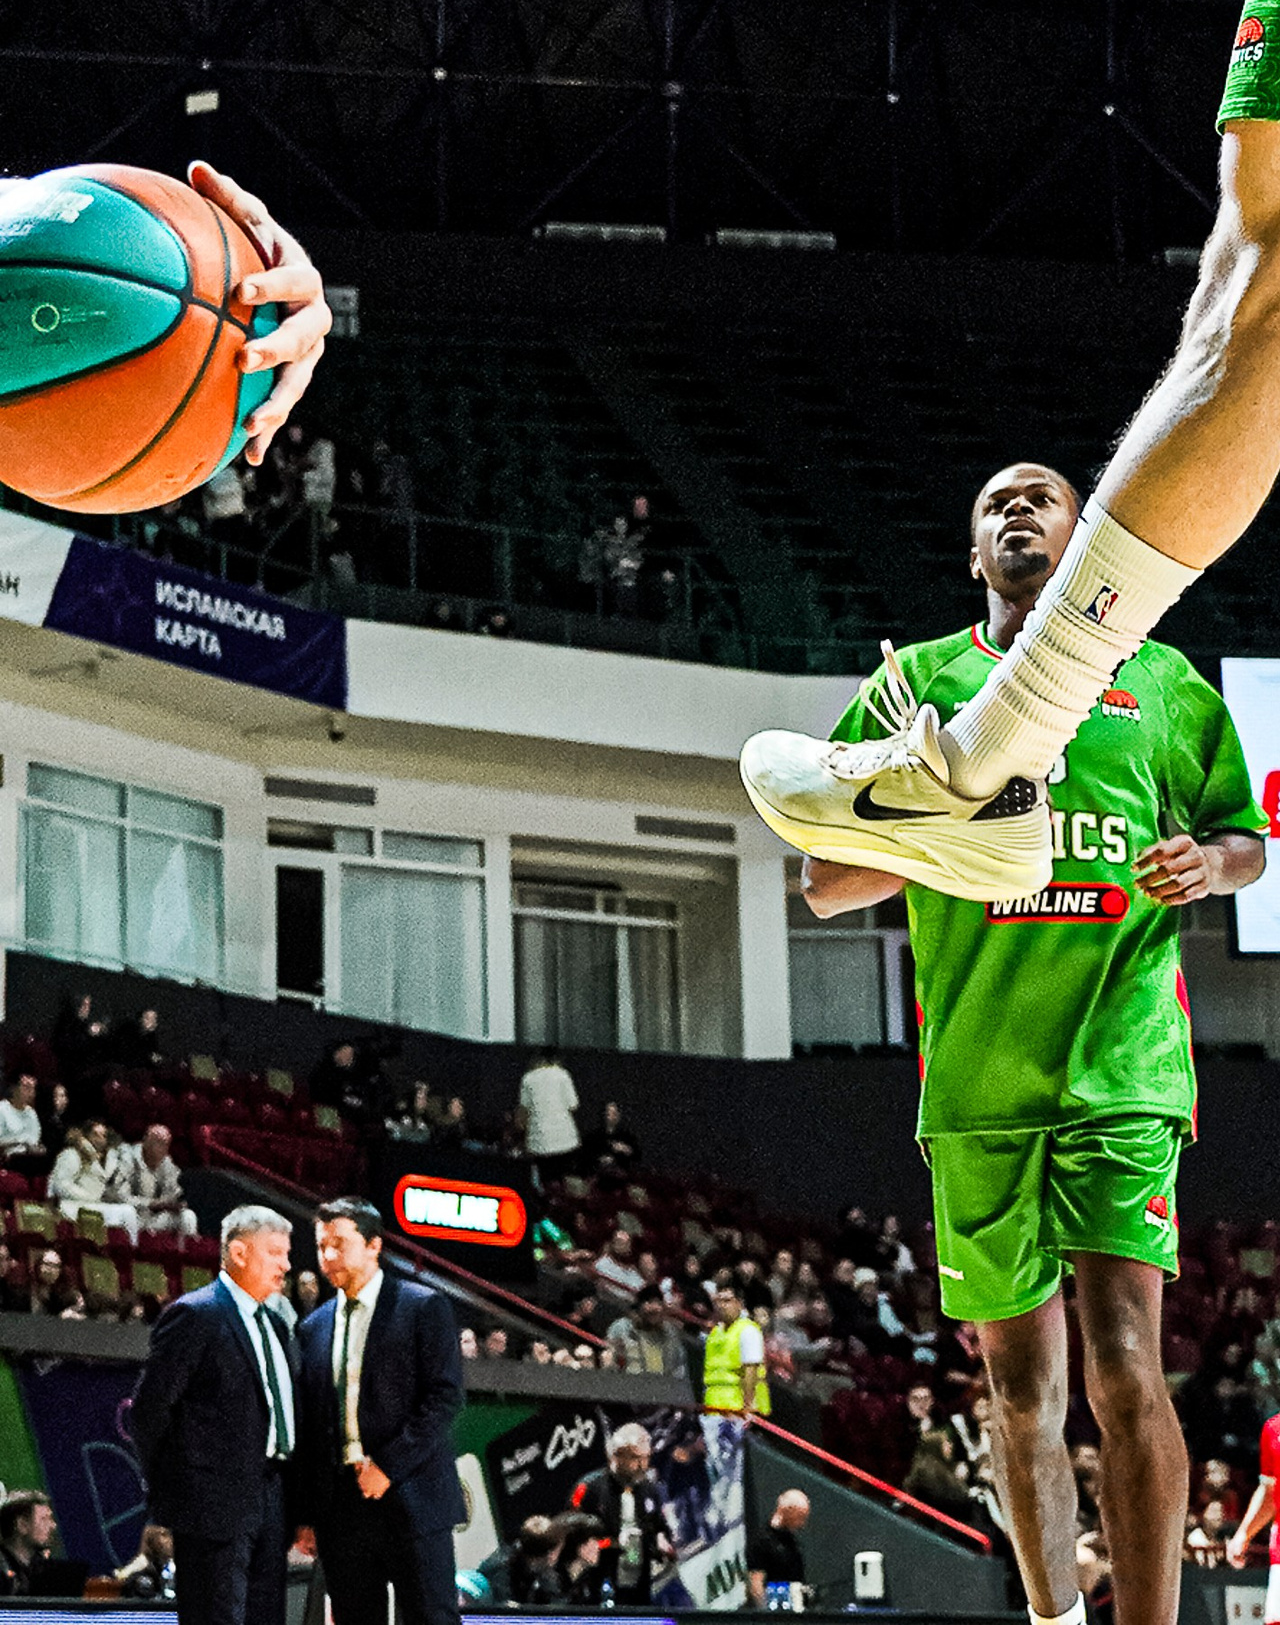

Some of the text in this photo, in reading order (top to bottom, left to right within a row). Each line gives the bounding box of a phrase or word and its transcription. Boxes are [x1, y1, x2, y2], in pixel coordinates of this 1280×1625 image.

[1232, 42, 1265, 62] ICS
[155, 579, 287, 642] ИСЛАМСКАЯ
[155, 617, 222, 660] КАРТА
[1053, 810, 1127, 864] ICS
[992, 890, 1098, 915] WINLINE
